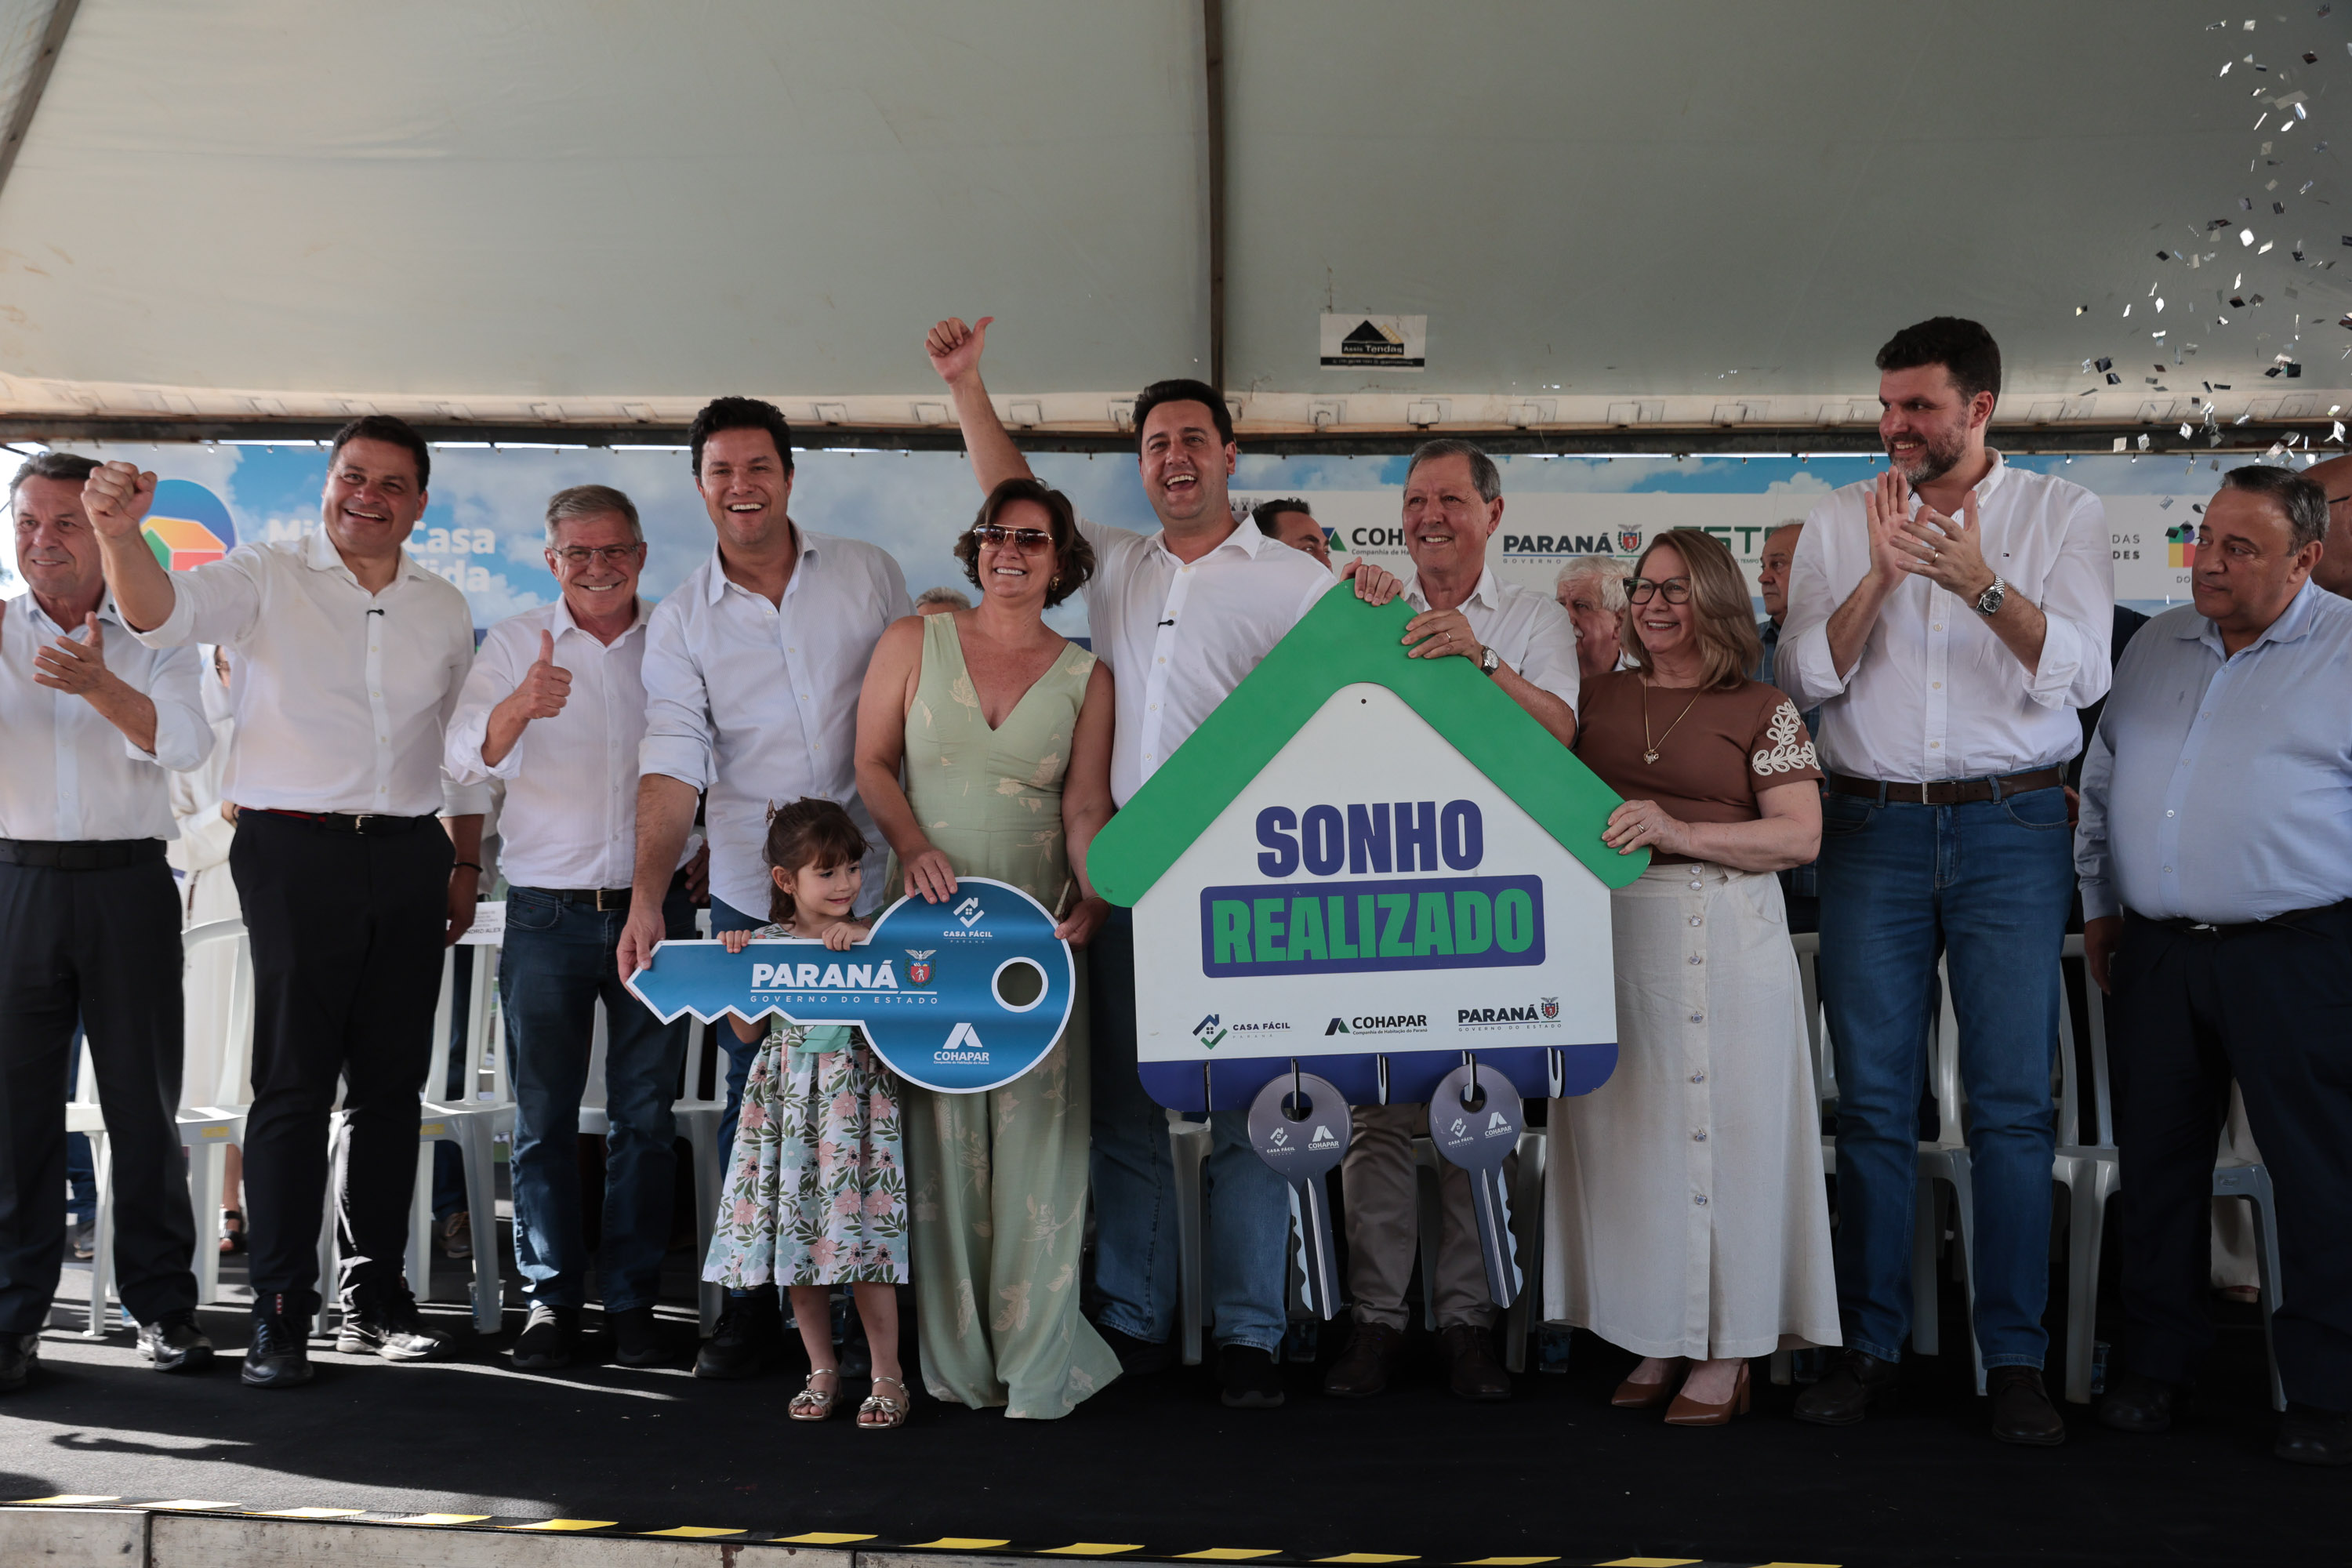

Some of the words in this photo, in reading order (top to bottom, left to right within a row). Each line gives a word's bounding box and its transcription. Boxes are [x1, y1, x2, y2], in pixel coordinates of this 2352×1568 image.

[1366, 344, 1403, 354] Tendas
[401, 521, 495, 554] Casa
[1352, 528, 1407, 546] COH
[1503, 532, 1613, 554] PARANÁ
[2112, 534, 2140, 544] DAS
[2113, 550, 2140, 560] DES
[416, 559, 490, 592] ida
[1255, 799, 1483, 877] SONHO
[1212, 888, 1534, 964] REALIZADO
[752, 960, 898, 989] PARANÁ
[1352, 1014, 1427, 1029] COHAPAR
[1458, 1004, 1539, 1023] PARANÁ
[934, 1051, 989, 1061] COHAPAR
[1485, 1125, 1512, 1137] COHAPAR
[1308, 1141, 1339, 1149] COHAPAR
